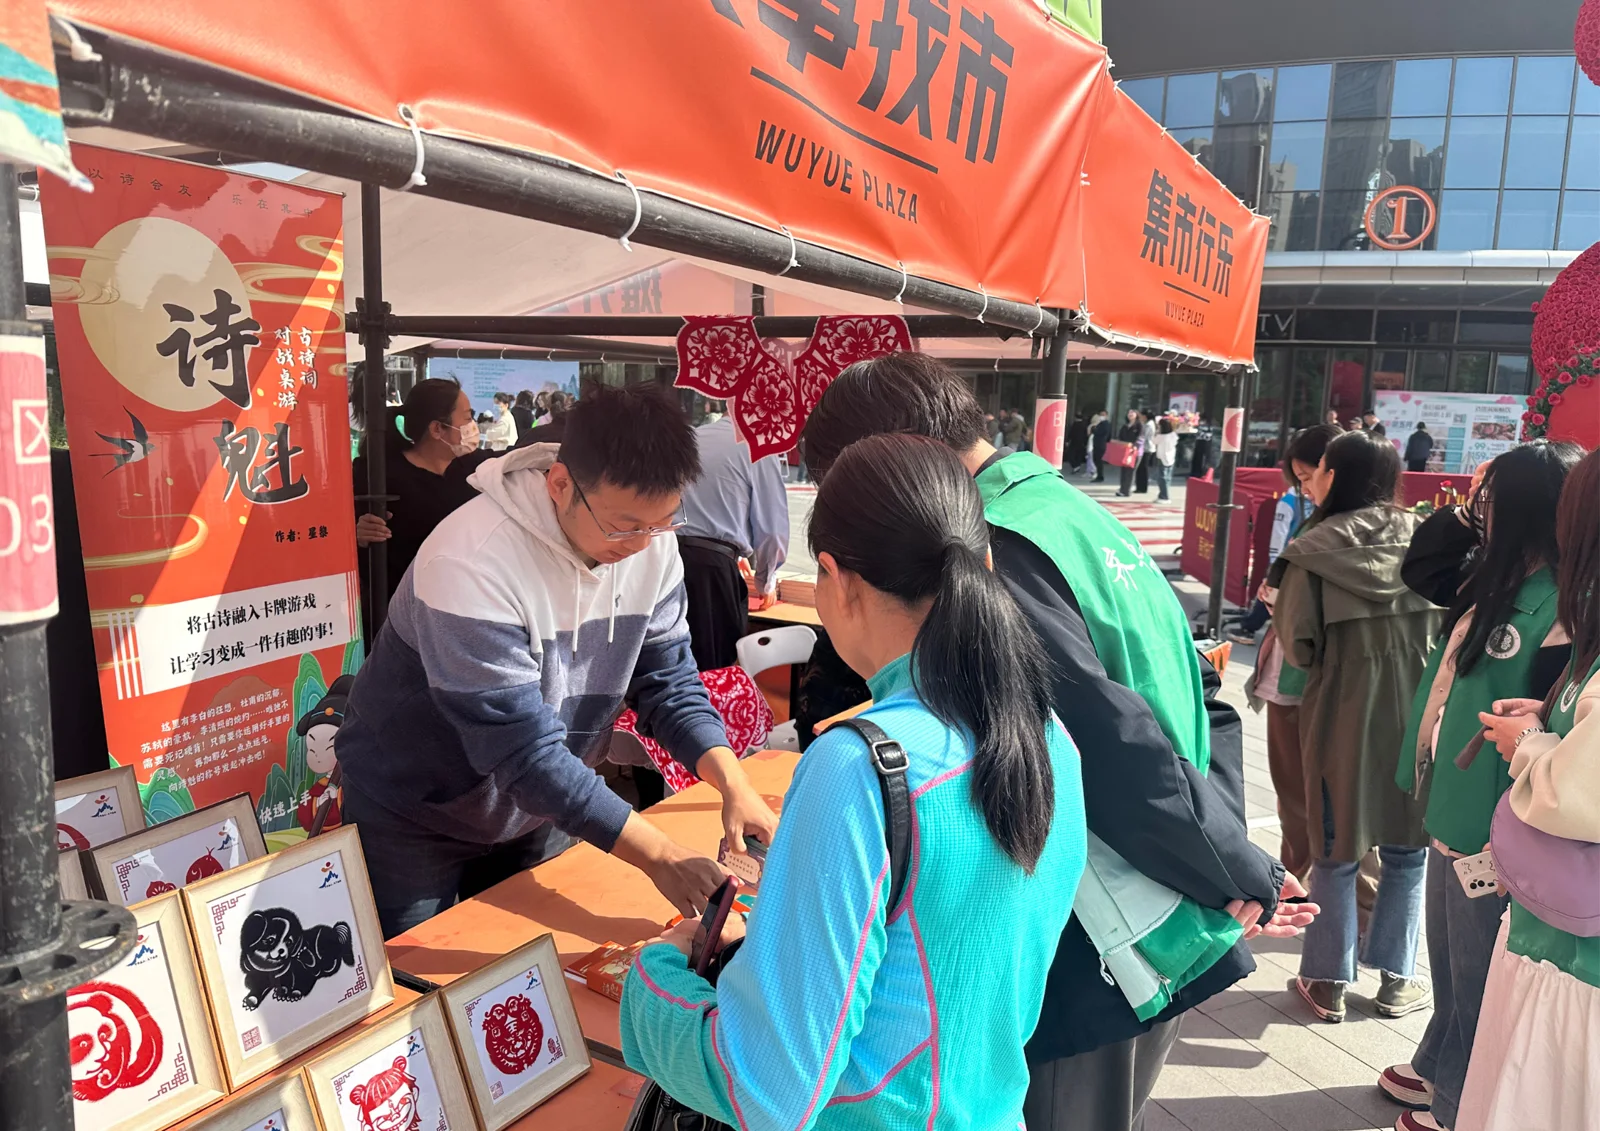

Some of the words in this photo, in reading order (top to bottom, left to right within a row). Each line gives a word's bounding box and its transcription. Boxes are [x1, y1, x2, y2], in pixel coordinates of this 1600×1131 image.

[754, 119, 853, 195] WUYUE
[862, 168, 919, 225] PLAZA
[1140, 168, 1234, 298] 集市行乐
[1165, 300, 1186, 322] WUYUE
[1186, 309, 1205, 328] PLAZA
[274, 327, 297, 410] 对战桌游
[298, 327, 318, 390] 古诗词
[169, 622, 334, 676] 让学习变成一件有趣的事！
[258, 790, 312, 824] 快速上手
